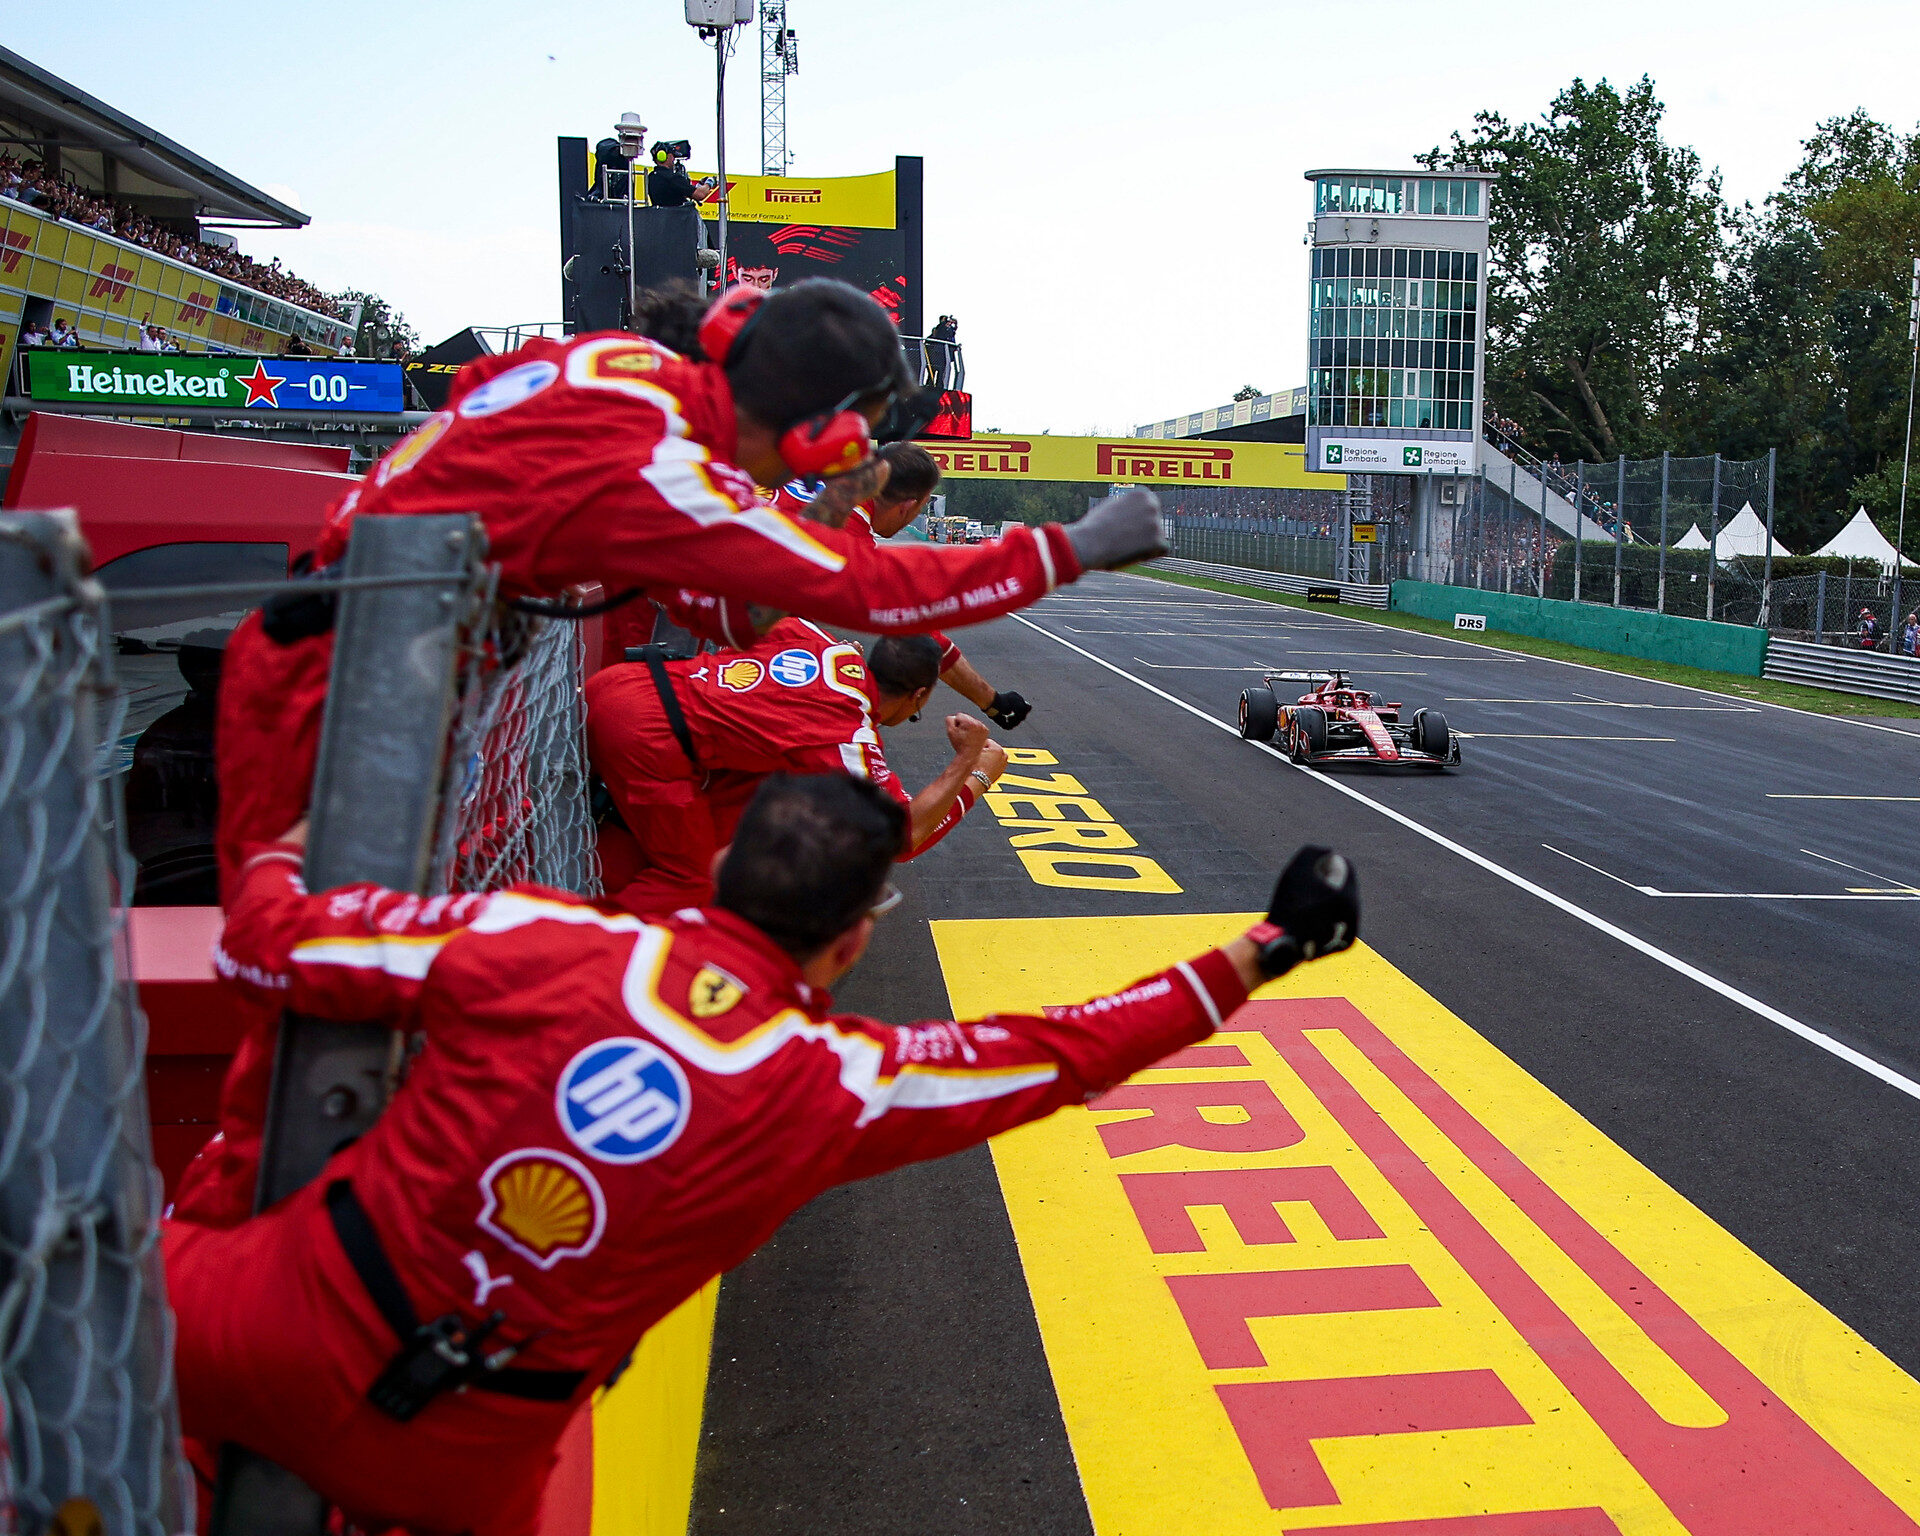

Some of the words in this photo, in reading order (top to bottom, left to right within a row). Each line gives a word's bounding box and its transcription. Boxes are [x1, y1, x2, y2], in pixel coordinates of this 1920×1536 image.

[765, 188, 821, 203] PIRELLI
[758, 212, 785, 220] Formula
[406, 362, 424, 371] P
[427, 364, 466, 374] ZE
[1344, 447, 1378, 456] Regione
[1424, 449, 1458, 458] Regione
[1097, 444, 1234, 479] PIRELLI
[1344, 455, 1387, 463] Lombardia
[1424, 458, 1467, 466] Lombardia
[962, 576, 1024, 608] MILLE
[1458, 618, 1483, 629] DRS
[770, 653, 817, 682] hp
[982, 773, 1185, 894] ZERO
[567, 1045, 682, 1150] hp
